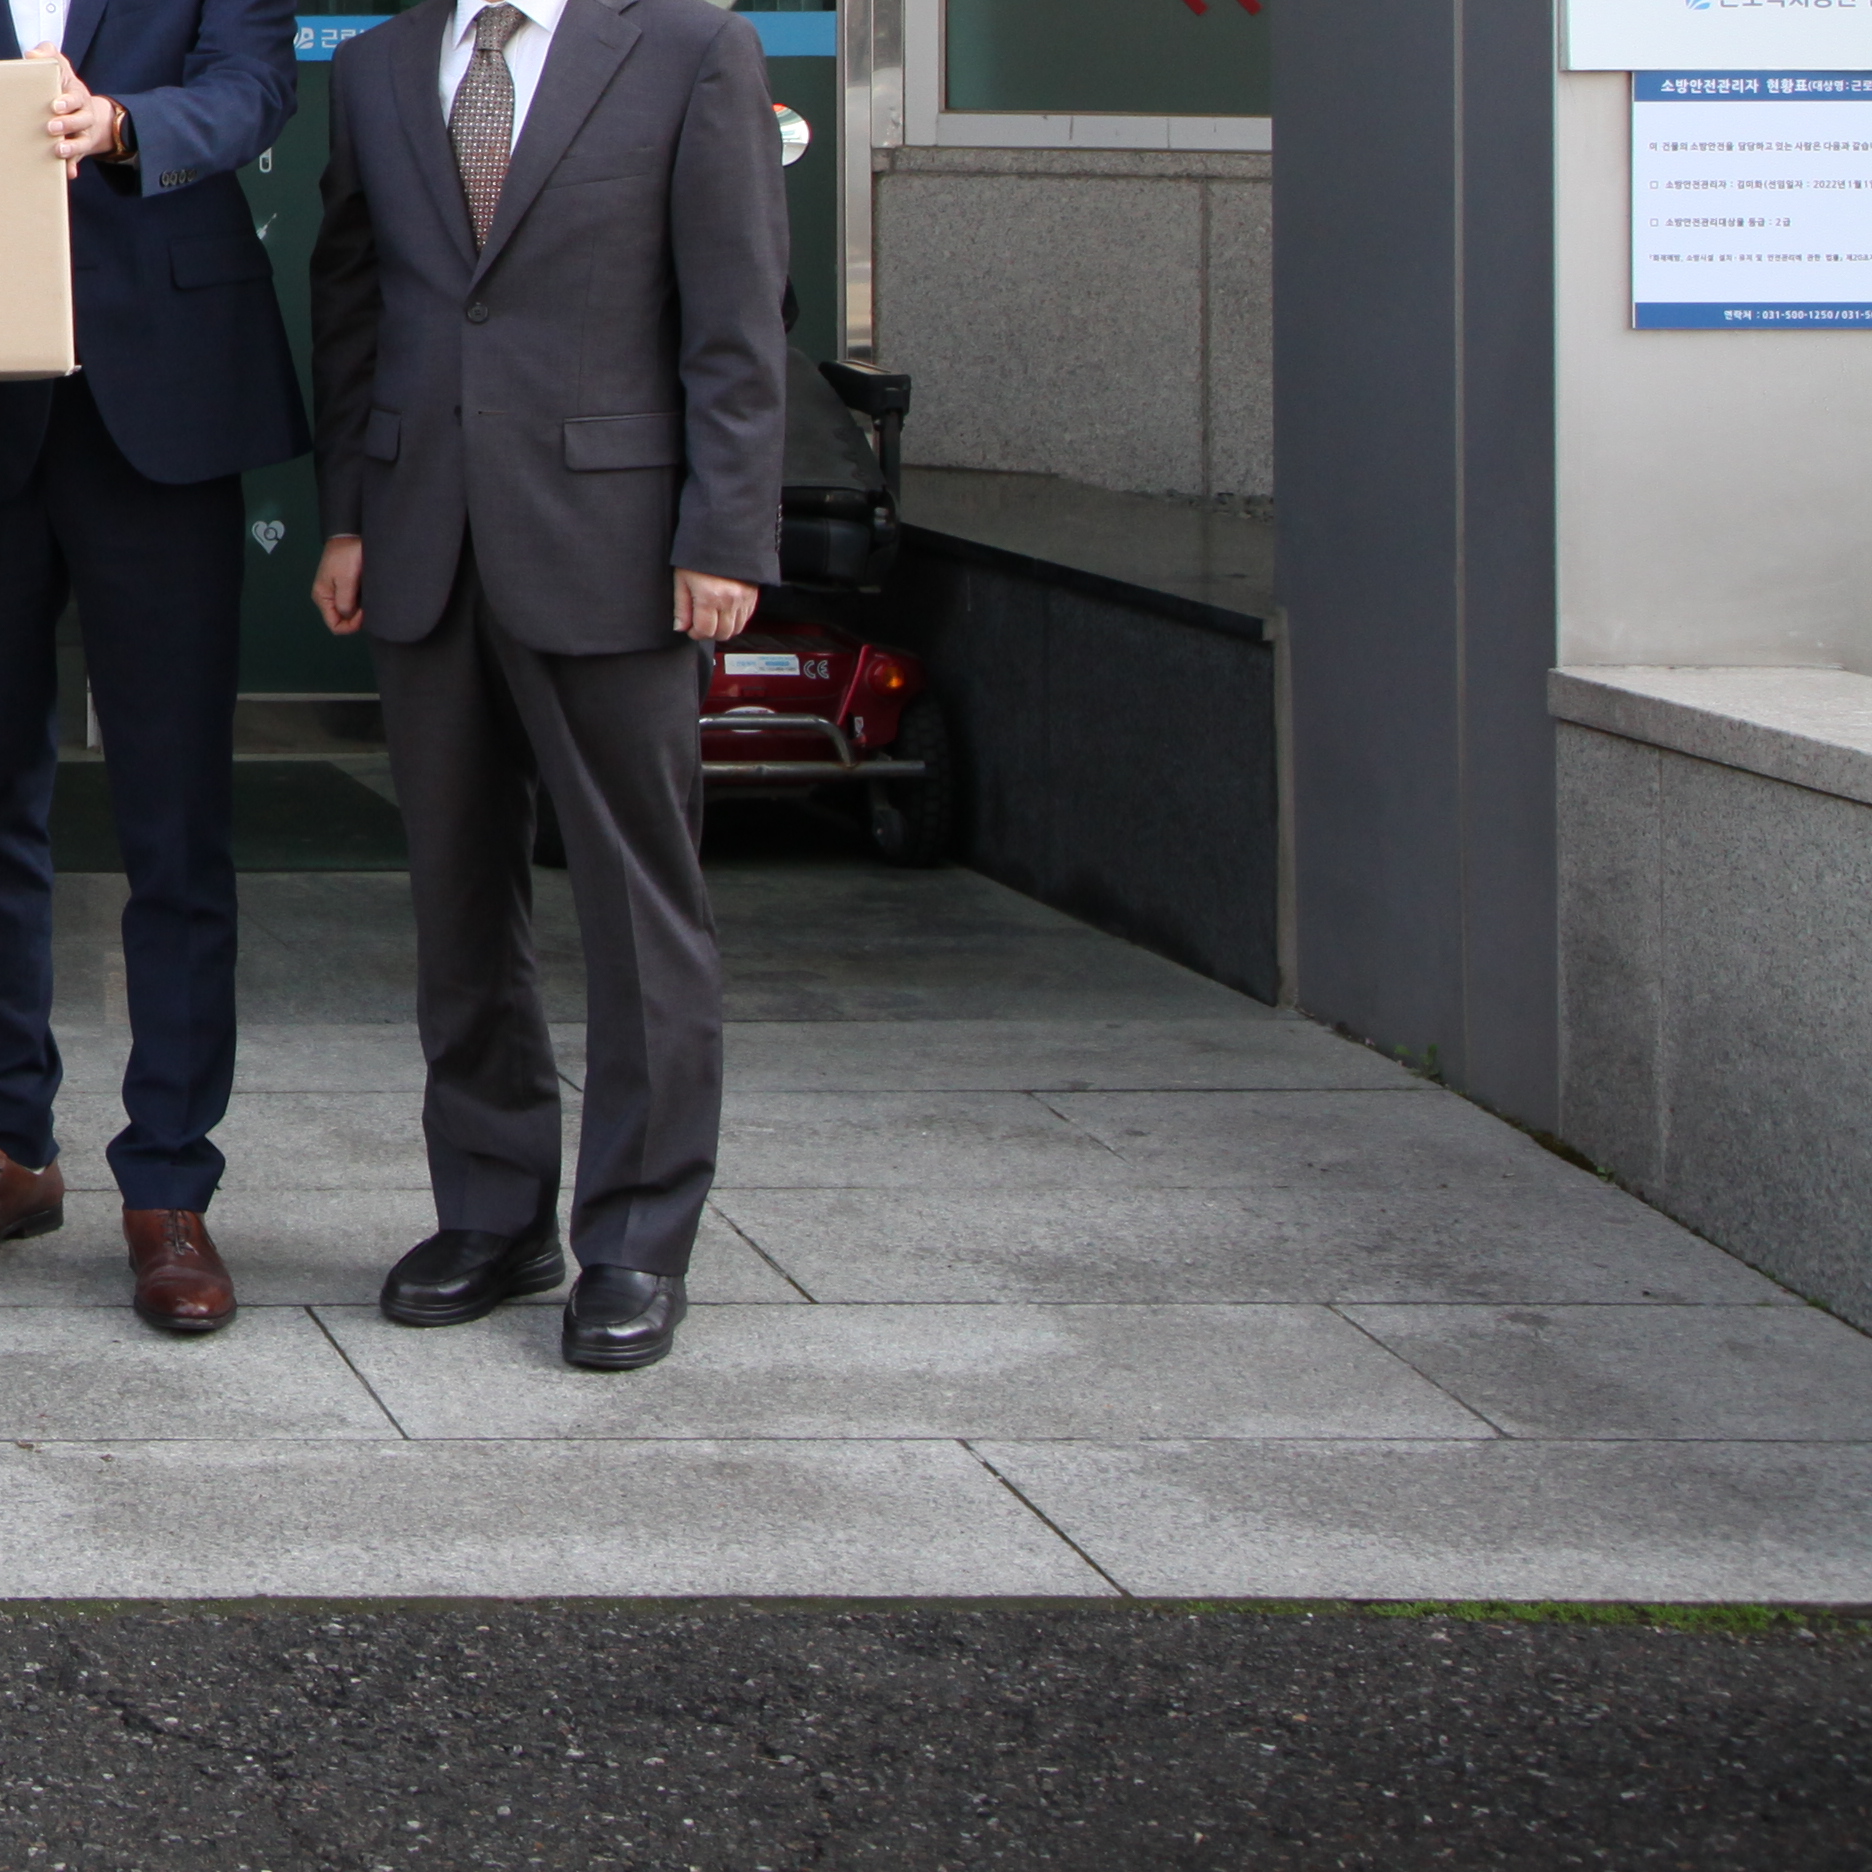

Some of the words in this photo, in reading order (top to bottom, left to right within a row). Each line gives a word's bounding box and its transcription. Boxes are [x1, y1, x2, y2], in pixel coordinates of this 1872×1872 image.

[1660, 78, 1759, 94] 소방안전관리자
[1841, 310, 1872, 320] 031-5
[803, 659, 830, 679] CE
